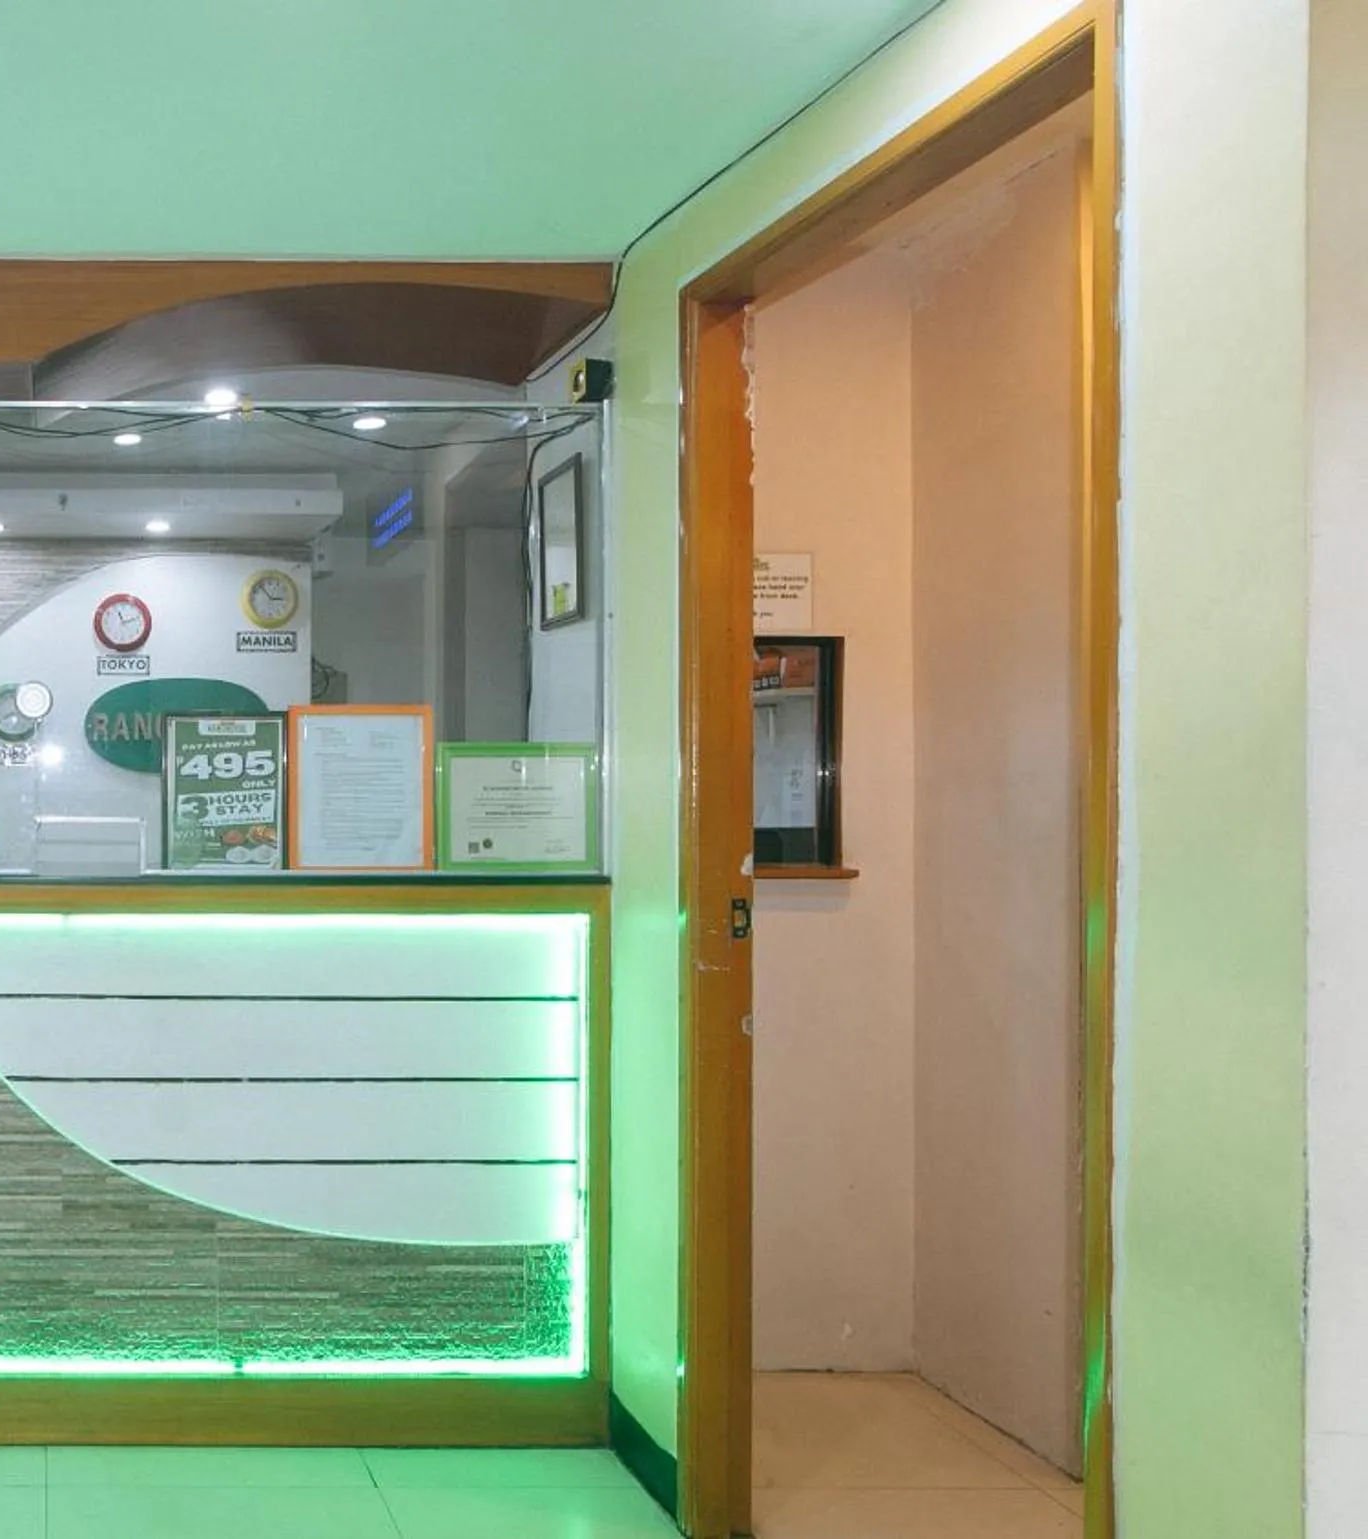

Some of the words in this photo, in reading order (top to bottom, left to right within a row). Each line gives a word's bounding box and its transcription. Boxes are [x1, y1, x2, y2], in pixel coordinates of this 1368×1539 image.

[240, 635, 293, 647] MANILA
[101, 659, 147, 670] TOKYO
[180, 749, 276, 780] 495
[241, 779, 276, 789] ONLY
[209, 792, 273, 805] HOURS
[180, 795, 209, 819] 3
[216, 802, 263, 815] STAY
